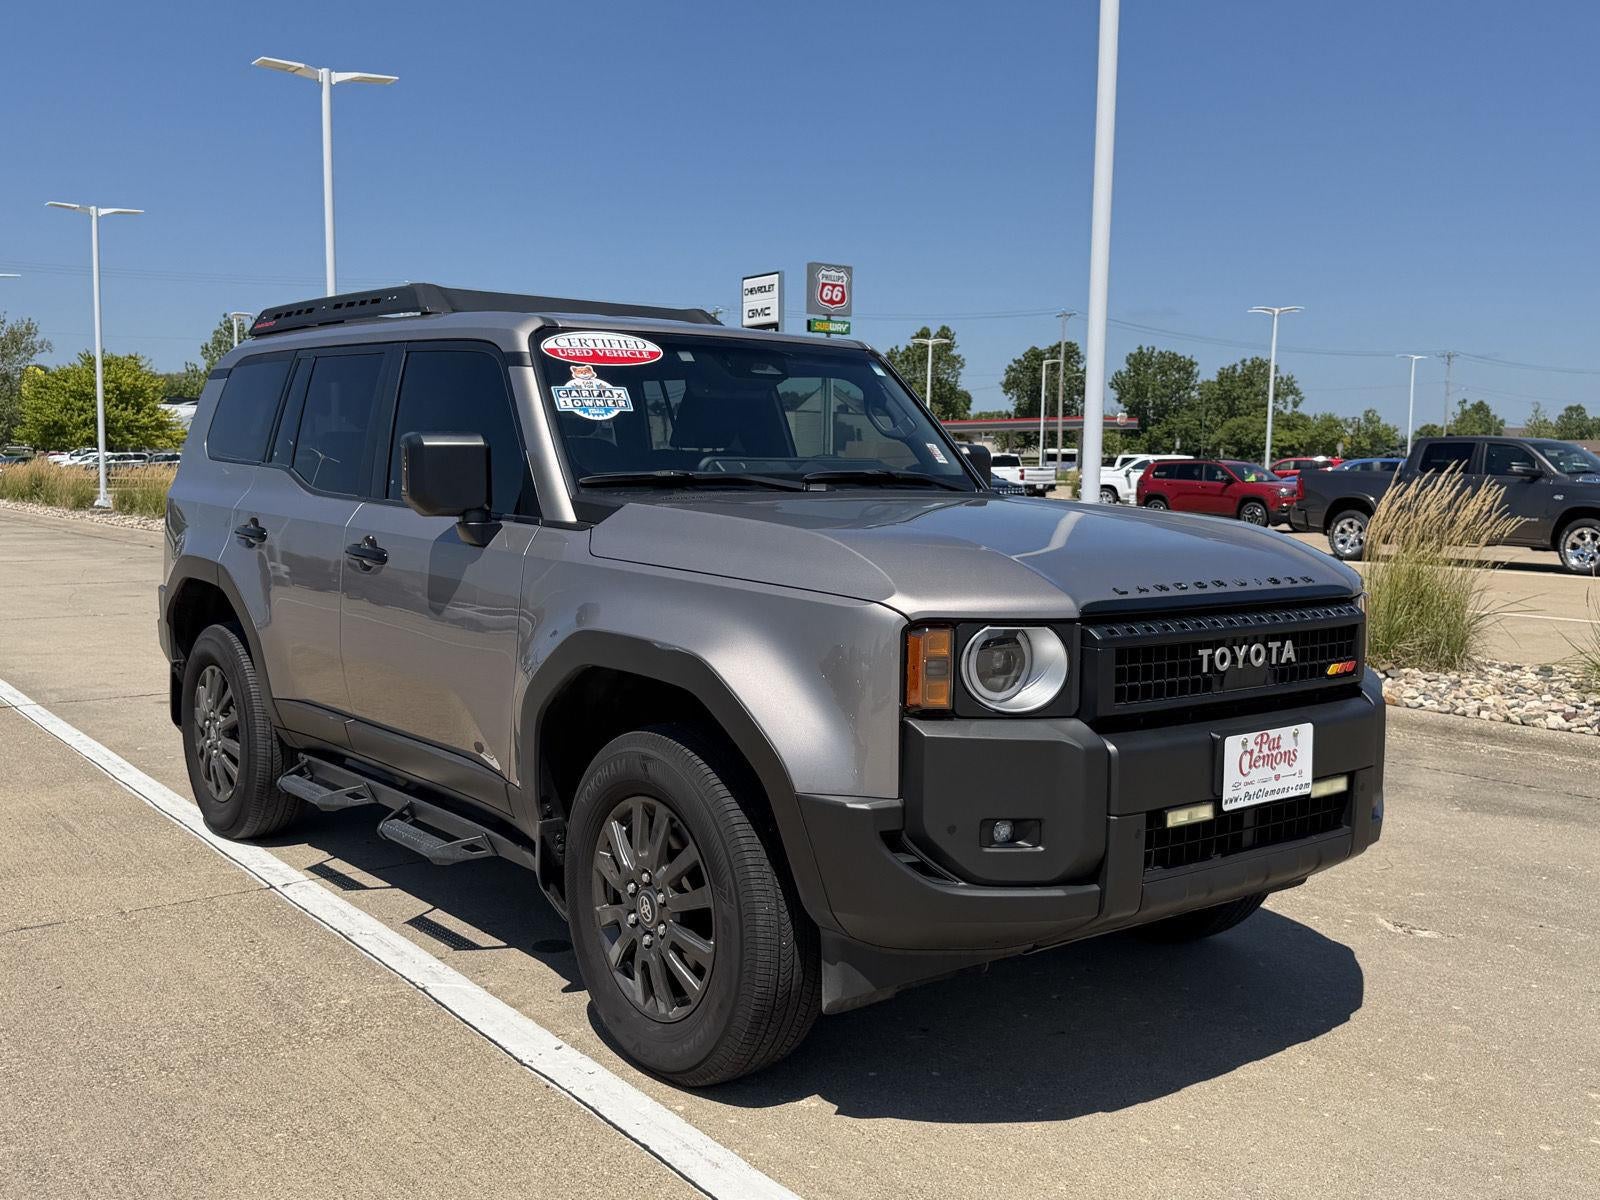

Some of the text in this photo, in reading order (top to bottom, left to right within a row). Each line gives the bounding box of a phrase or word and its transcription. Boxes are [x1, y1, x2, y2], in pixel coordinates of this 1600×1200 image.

[744, 284, 775, 296] CHEVROLET
[822, 285, 843, 302] 66
[748, 307, 771, 318] GMC
[814, 321, 849, 332] SUBWAY
[555, 338, 647, 350] CERTIFIED
[557, 348, 651, 359] USED VEHICLE
[559, 389, 624, 399] CARFAX
[572, 400, 628, 408] OWNER
[1199, 640, 1297, 673] TOYOTA
[1254, 732, 1282, 753] Pat
[1239, 749, 1299, 777] Clemons
[1224, 782, 1311, 805] www.PatClemons.com
